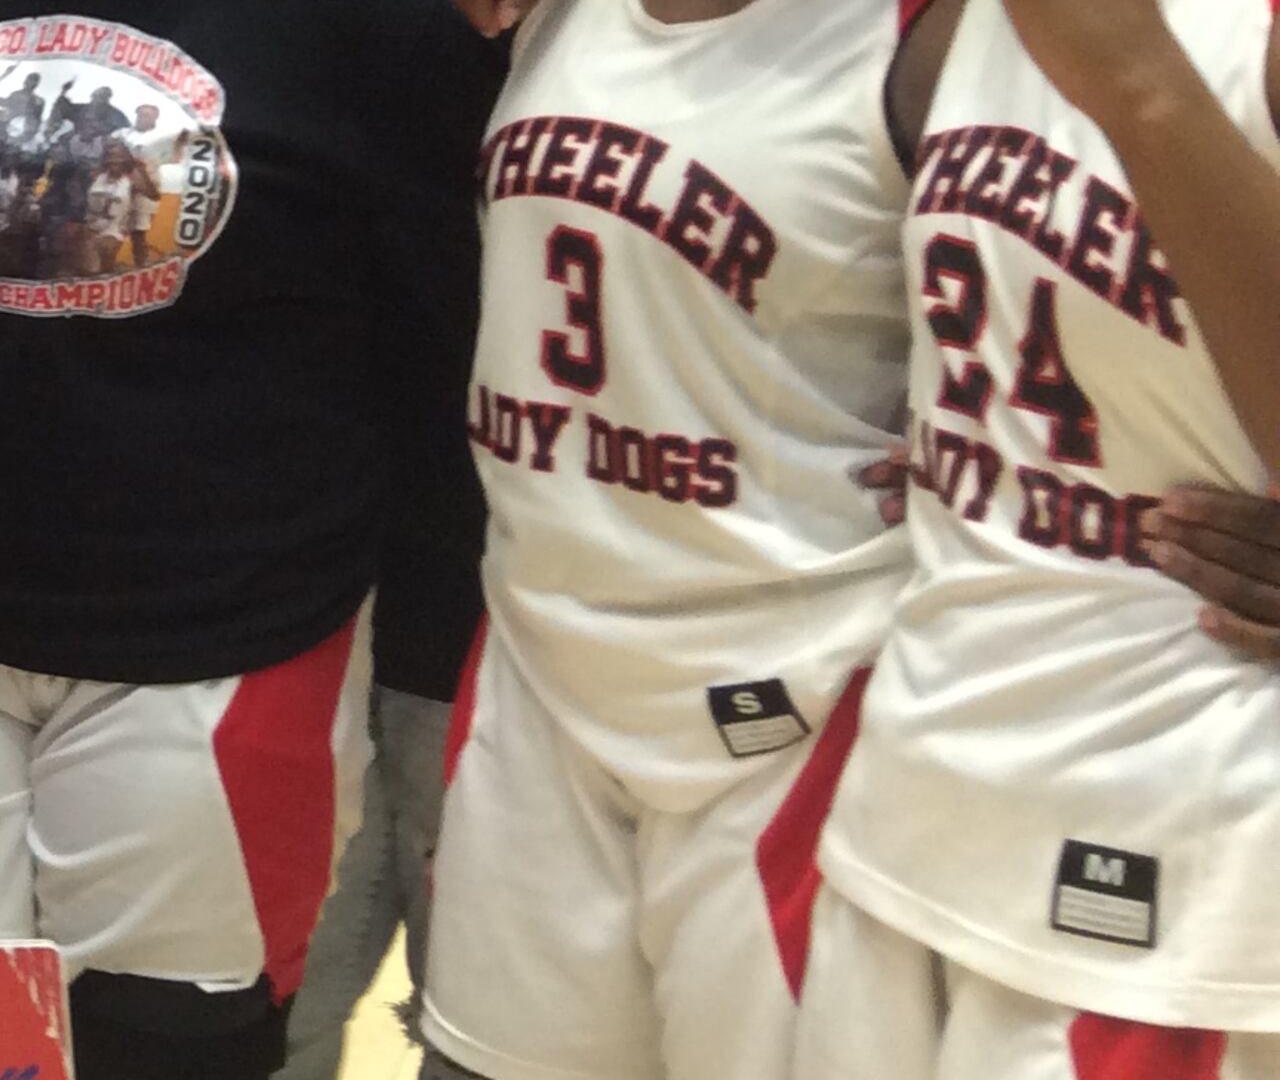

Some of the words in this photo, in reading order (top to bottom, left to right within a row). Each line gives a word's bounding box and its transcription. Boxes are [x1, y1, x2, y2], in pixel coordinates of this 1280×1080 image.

[35, 22, 110, 55] LADY
[179, 140, 212, 240] 2020
[539, 224, 606, 397] 3
[922, 232, 1104, 469] 24
[586, 413, 736, 507] DOGS
[731, 691, 763, 715] S
[1083, 852, 1127, 887] M
